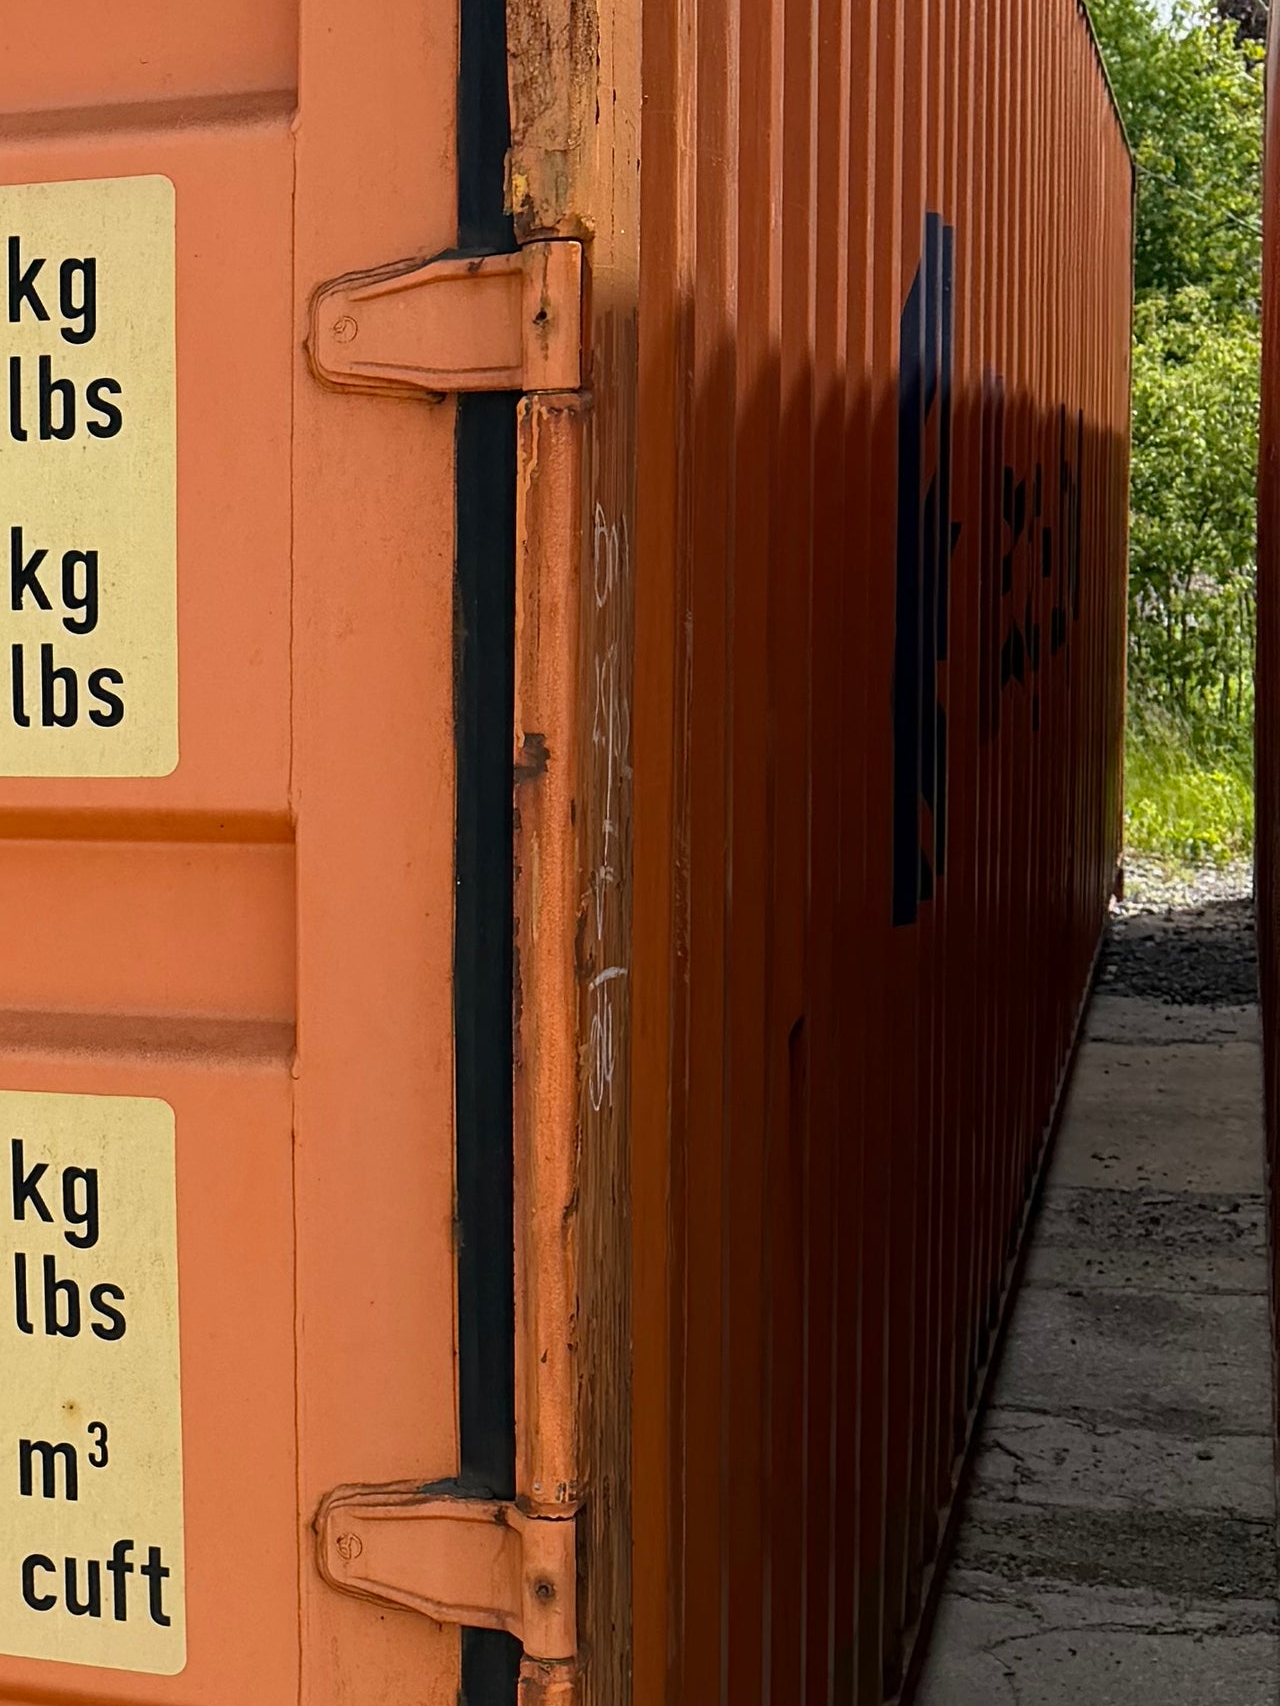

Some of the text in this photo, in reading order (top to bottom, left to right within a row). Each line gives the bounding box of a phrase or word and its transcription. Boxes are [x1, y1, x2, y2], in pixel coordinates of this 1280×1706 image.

[8, 236, 98, 345] kg
[9, 355, 123, 442] lbs
[10, 526, 100, 635] kg
[12, 643, 126, 728] lbs
[10, 1138, 99, 1249] kg
[14, 1252, 127, 1341] lbs
[21, 1539, 171, 1627] cuft
